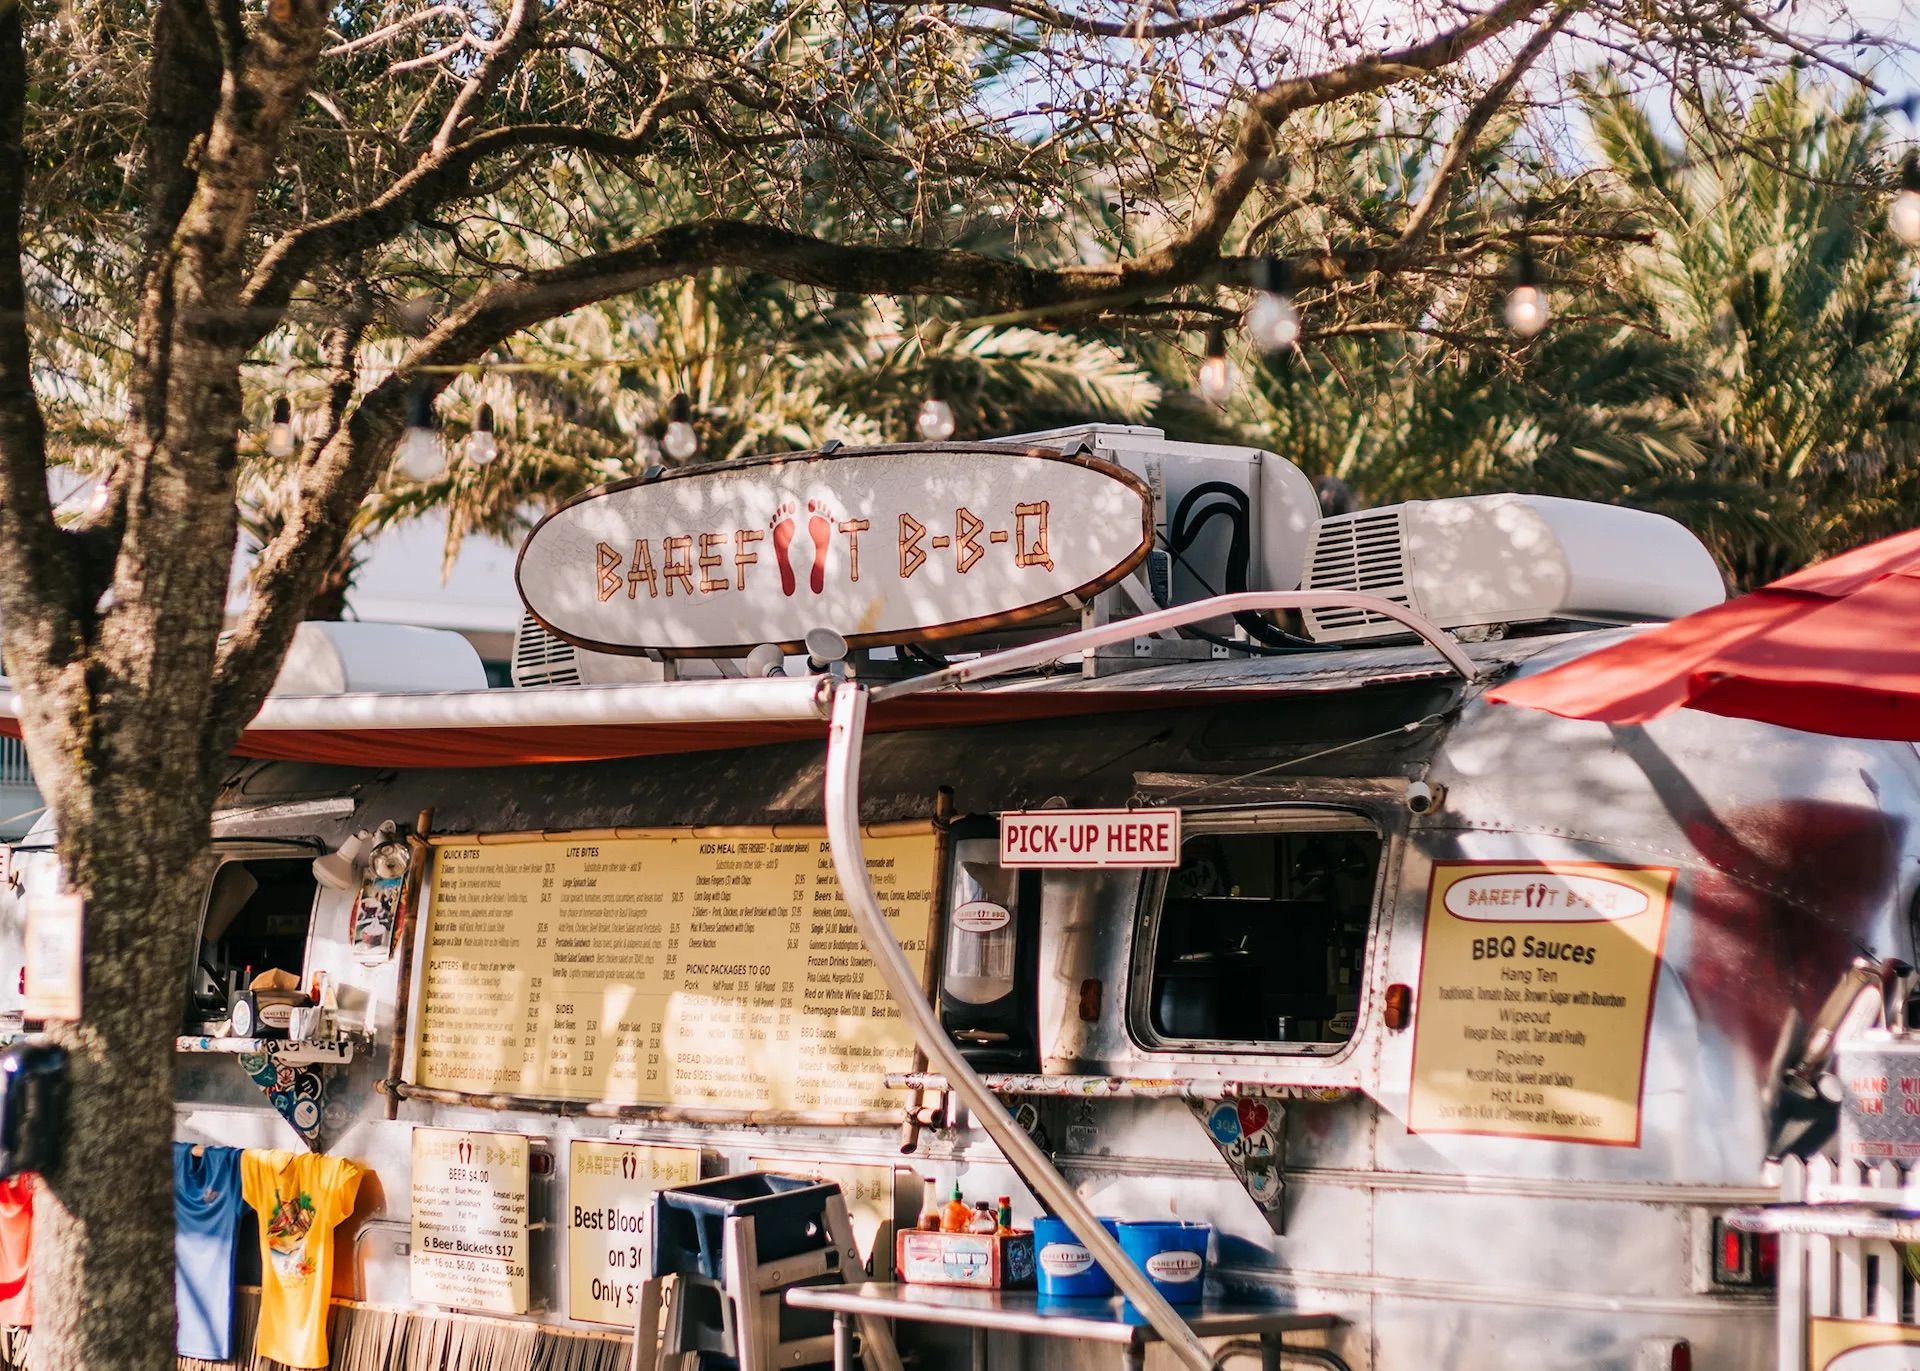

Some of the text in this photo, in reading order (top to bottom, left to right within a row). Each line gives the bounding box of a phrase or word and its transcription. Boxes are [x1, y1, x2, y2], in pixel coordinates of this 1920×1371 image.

[596, 498, 1055, 602] BAREFT B-B-Q
[1007, 823, 1169, 853] PICK-UP HERE
[443, 849, 480, 859] QUICK BITES
[566, 847, 599, 858] LITE BITES
[700, 843, 736, 854] KIDS MEAL
[815, 890, 831, 901] Beers
[1472, 935, 1596, 965] BBQ Sauces
[429, 960, 459, 970] PLATTERS
[808, 955, 829, 967] Frozen
[829, 955, 849, 967] Drinks
[686, 964, 771, 976] PICNIC PACKAGES TO GO
[1501, 967, 1558, 984] Hang Ten
[684, 979, 699, 991] Pork
[804, 988, 816, 1000] Red
[817, 990, 825, 999] or
[825, 988, 843, 1000] White
[845, 989, 861, 1000] Wine
[1524, 987, 1547, 1003] Brown
[1550, 989, 1570, 1006] Sugar
[1573, 990, 1590, 1005] with
[1592, 991, 1626, 1008] Bourbon
[555, 1004, 575, 1014] SIDES
[803, 1004, 838, 1018] Champagne
[872, 1005, 886, 1017] Best
[1498, 1007, 1551, 1025] Wipeout
[816, 1028, 836, 1040] Sauces
[1464, 1025, 1489, 1042] Vinegar
[1549, 1030, 1563, 1044] and
[1496, 1049, 1544, 1067] Pipeline
[1538, 1073, 1553, 1086] and
[1491, 1088, 1544, 1105] Hot Lava
[449, 1167, 489, 1183] BEER $4.00
[492, 1189, 525, 1202] Amstel Light
[492, 1203, 525, 1215] Corona Light
[499, 1215, 518, 1225] Corona
[574, 1205, 603, 1228] Best
[503, 1230, 519, 1240] $5.00
[424, 1235, 513, 1257] 6 Beer Buckets $17
[608, 1248, 625, 1267] on
[506, 1264, 524, 1278] $8.00
[592, 1277, 621, 1308] Only
